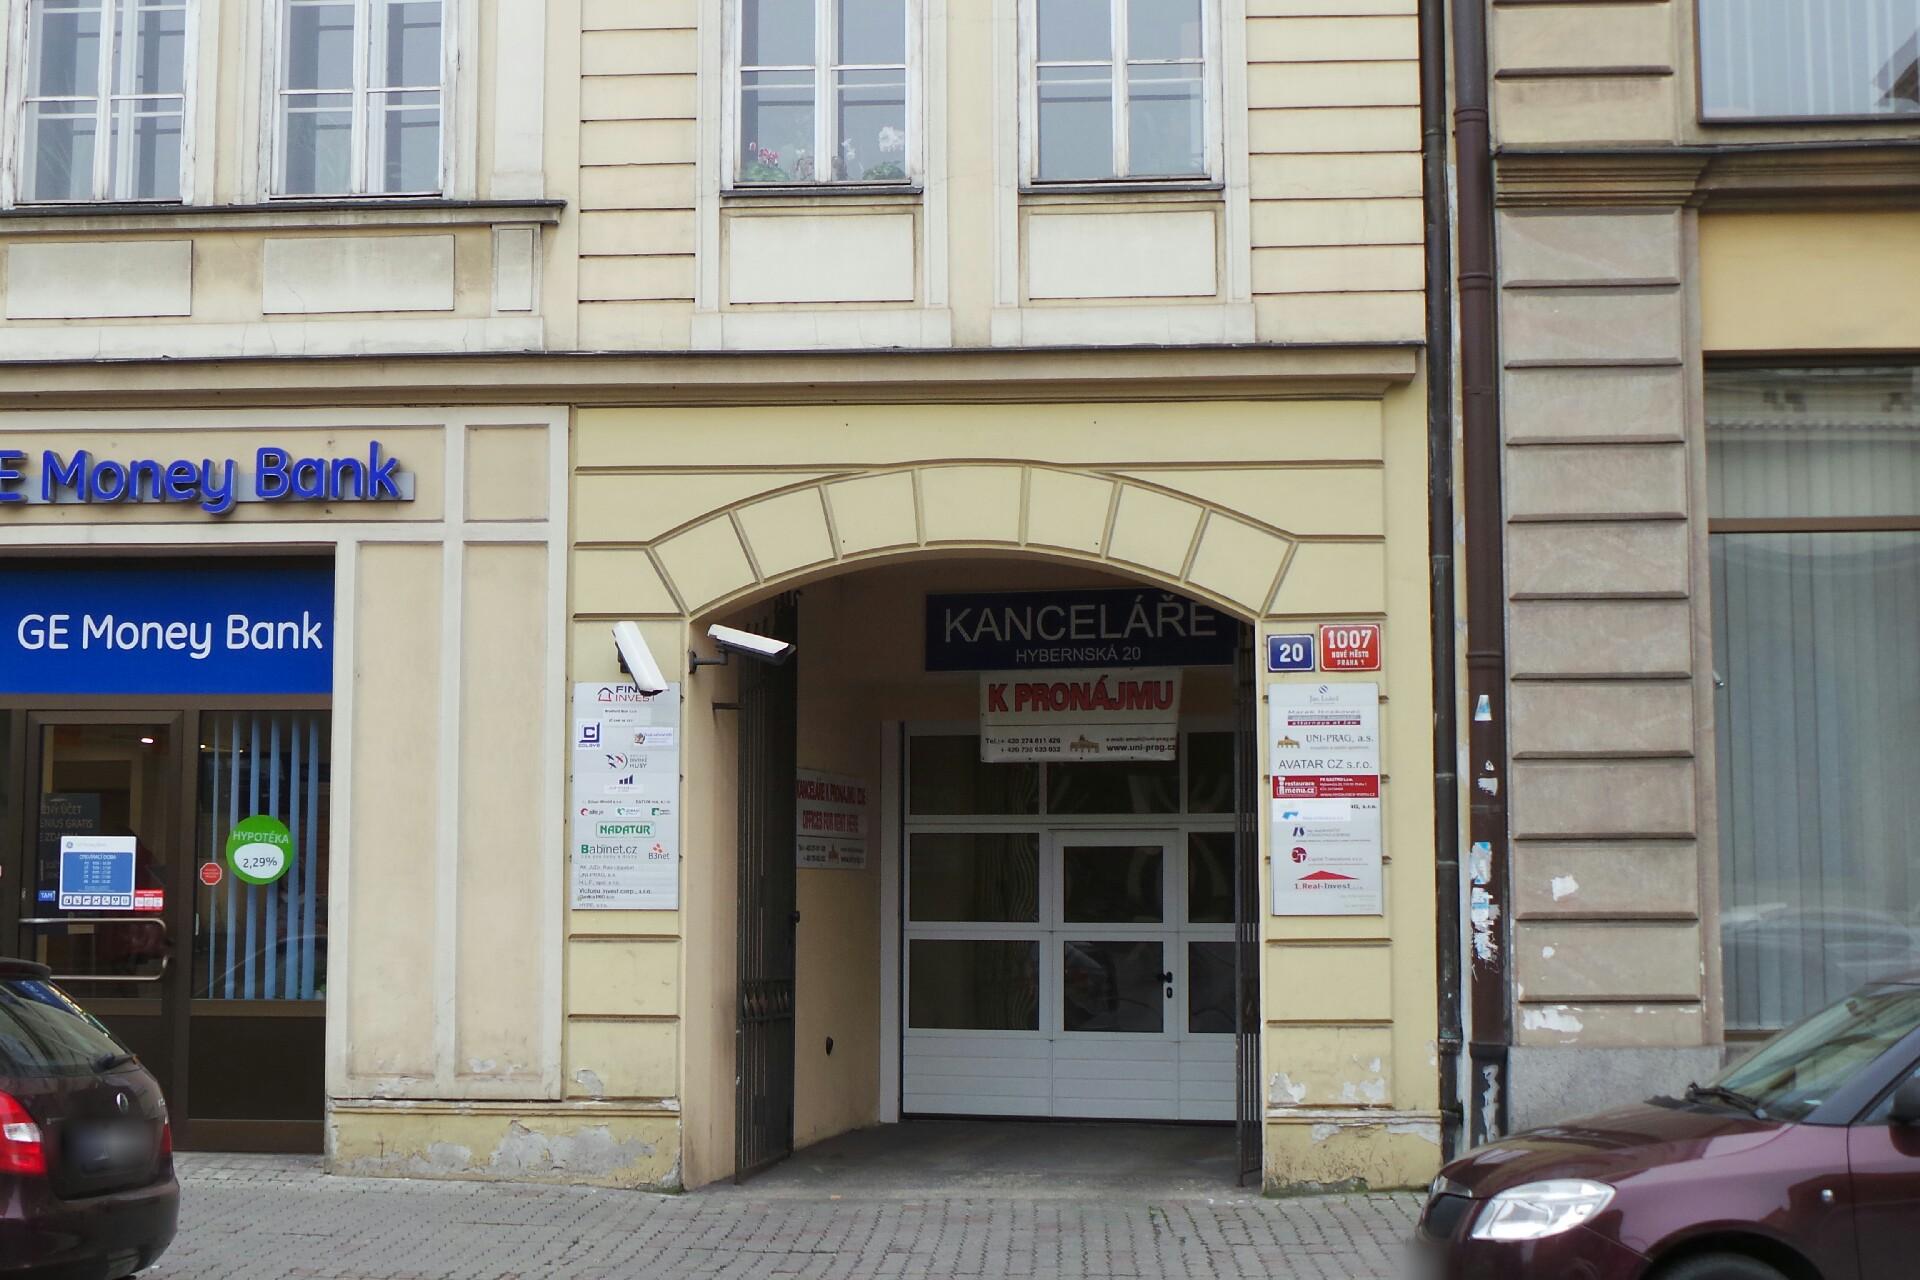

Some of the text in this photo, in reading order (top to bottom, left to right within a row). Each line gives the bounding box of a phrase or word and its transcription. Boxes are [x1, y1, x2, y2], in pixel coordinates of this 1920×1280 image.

[42, 449, 239, 517] Money
[254, 440, 402, 501] Bank
[945, 594, 1217, 643] KANCELÁŘE
[17, 610, 324, 660] GE Money Bank
[1327, 629, 1372, 649] 1007
[1015, 644, 1142, 663] HYBERNSKÁ 20
[1279, 642, 1304, 663] 20
[1331, 649, 1369, 659] NOVÉ MĚSTO
[988, 674, 1174, 713] K PRONÁJMU
[1305, 734, 1354, 743] UNI-PRAG,
[1278, 759, 1373, 769] AVATAR CZ s.r.o.
[232, 830, 289, 844] HYPOTÉKA
[600, 825, 651, 835] NADATUR
[580, 844, 638, 856] Babinet.cz
[243, 857, 278, 869] 2,29%
